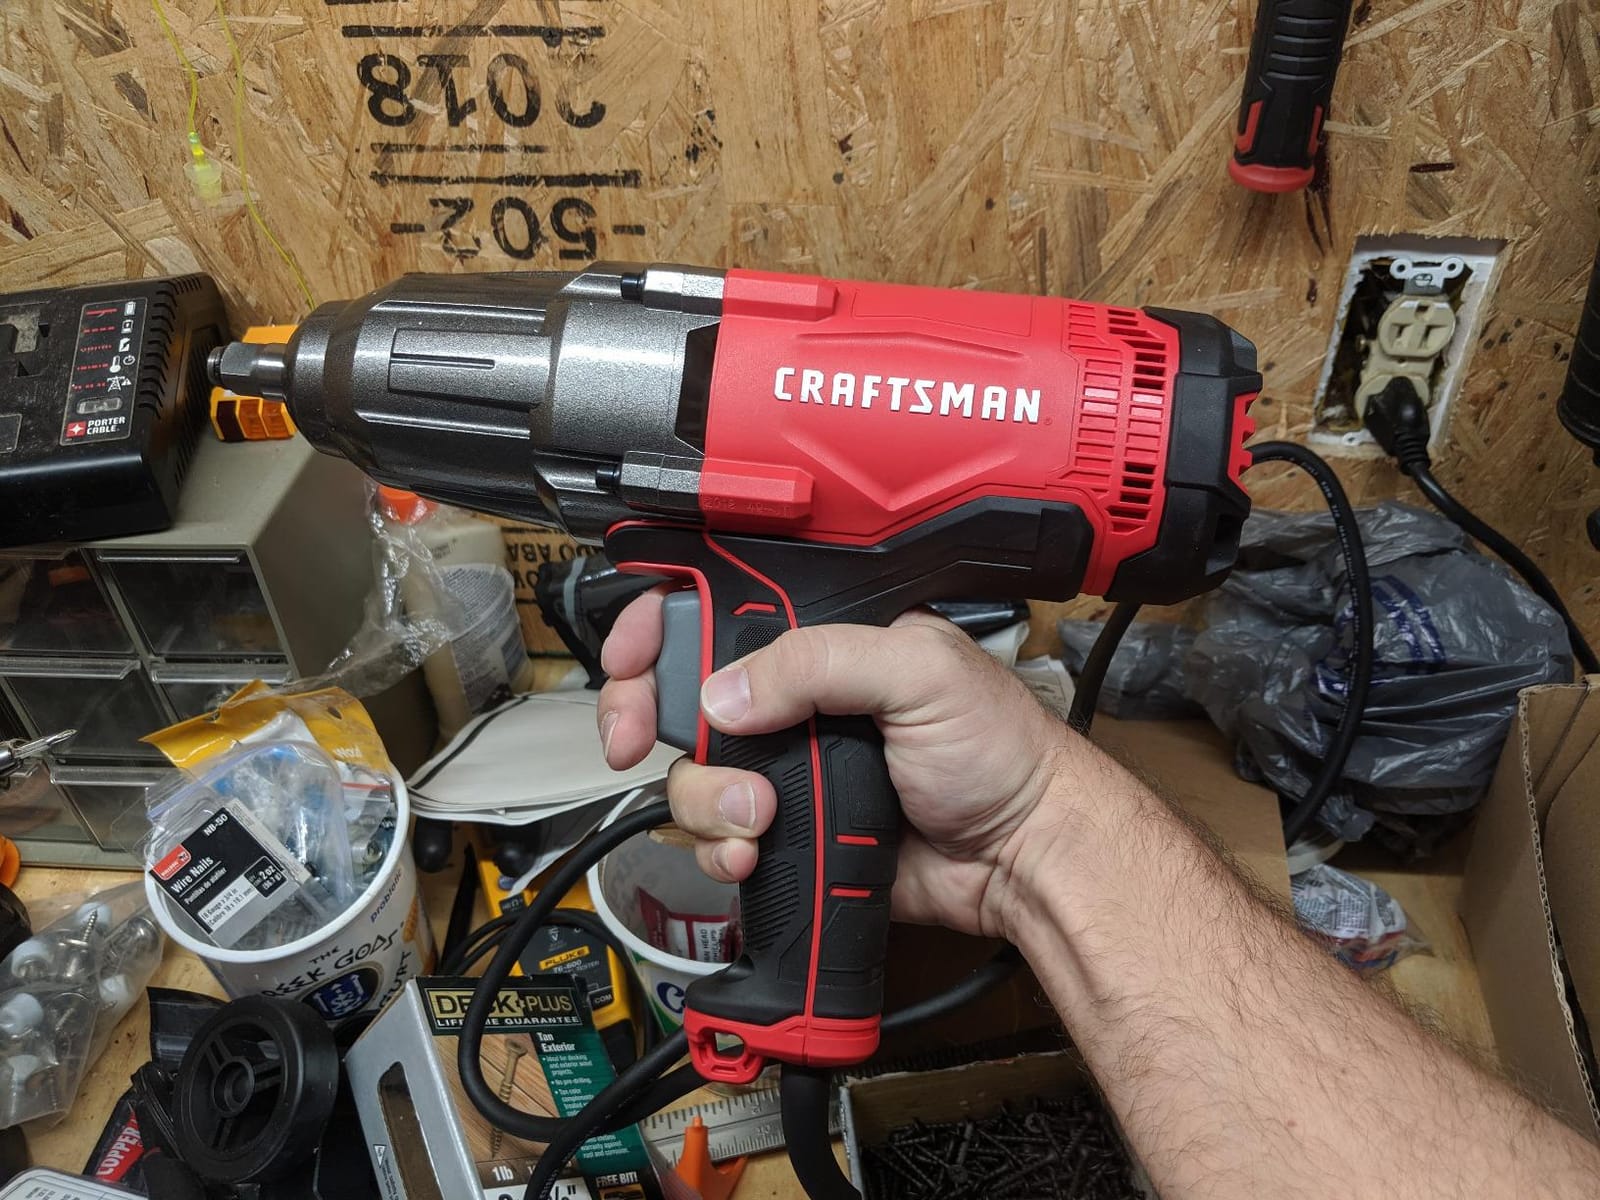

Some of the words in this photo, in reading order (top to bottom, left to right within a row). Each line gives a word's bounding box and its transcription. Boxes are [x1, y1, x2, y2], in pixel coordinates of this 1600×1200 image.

[774, 367, 1042, 424] CRAFTSMAN
[87, 416, 126, 428] PORTER
[87, 425, 118, 435] CABLE
[203, 814, 228, 836] NB-50
[171, 875, 193, 893] Wire
[189, 857, 214, 877] Nails
[370, 868, 402, 923] probiotic
[309, 946, 339, 965] THE
[544, 949, 586, 967] FLUKE
[435, 995, 517, 1014] DEK
[526, 996, 573, 1012] PLUS
[594, 994, 612, 1003] COM
[504, 1017, 579, 1025] GUARANTEE
[537, 1032, 554, 1041] Tan
[541, 1042, 576, 1053] Exterior
[96, 1126, 141, 1175] COPPER
[596, 1175, 617, 1188] FREE
[620, 1171, 639, 1183] BIT!
